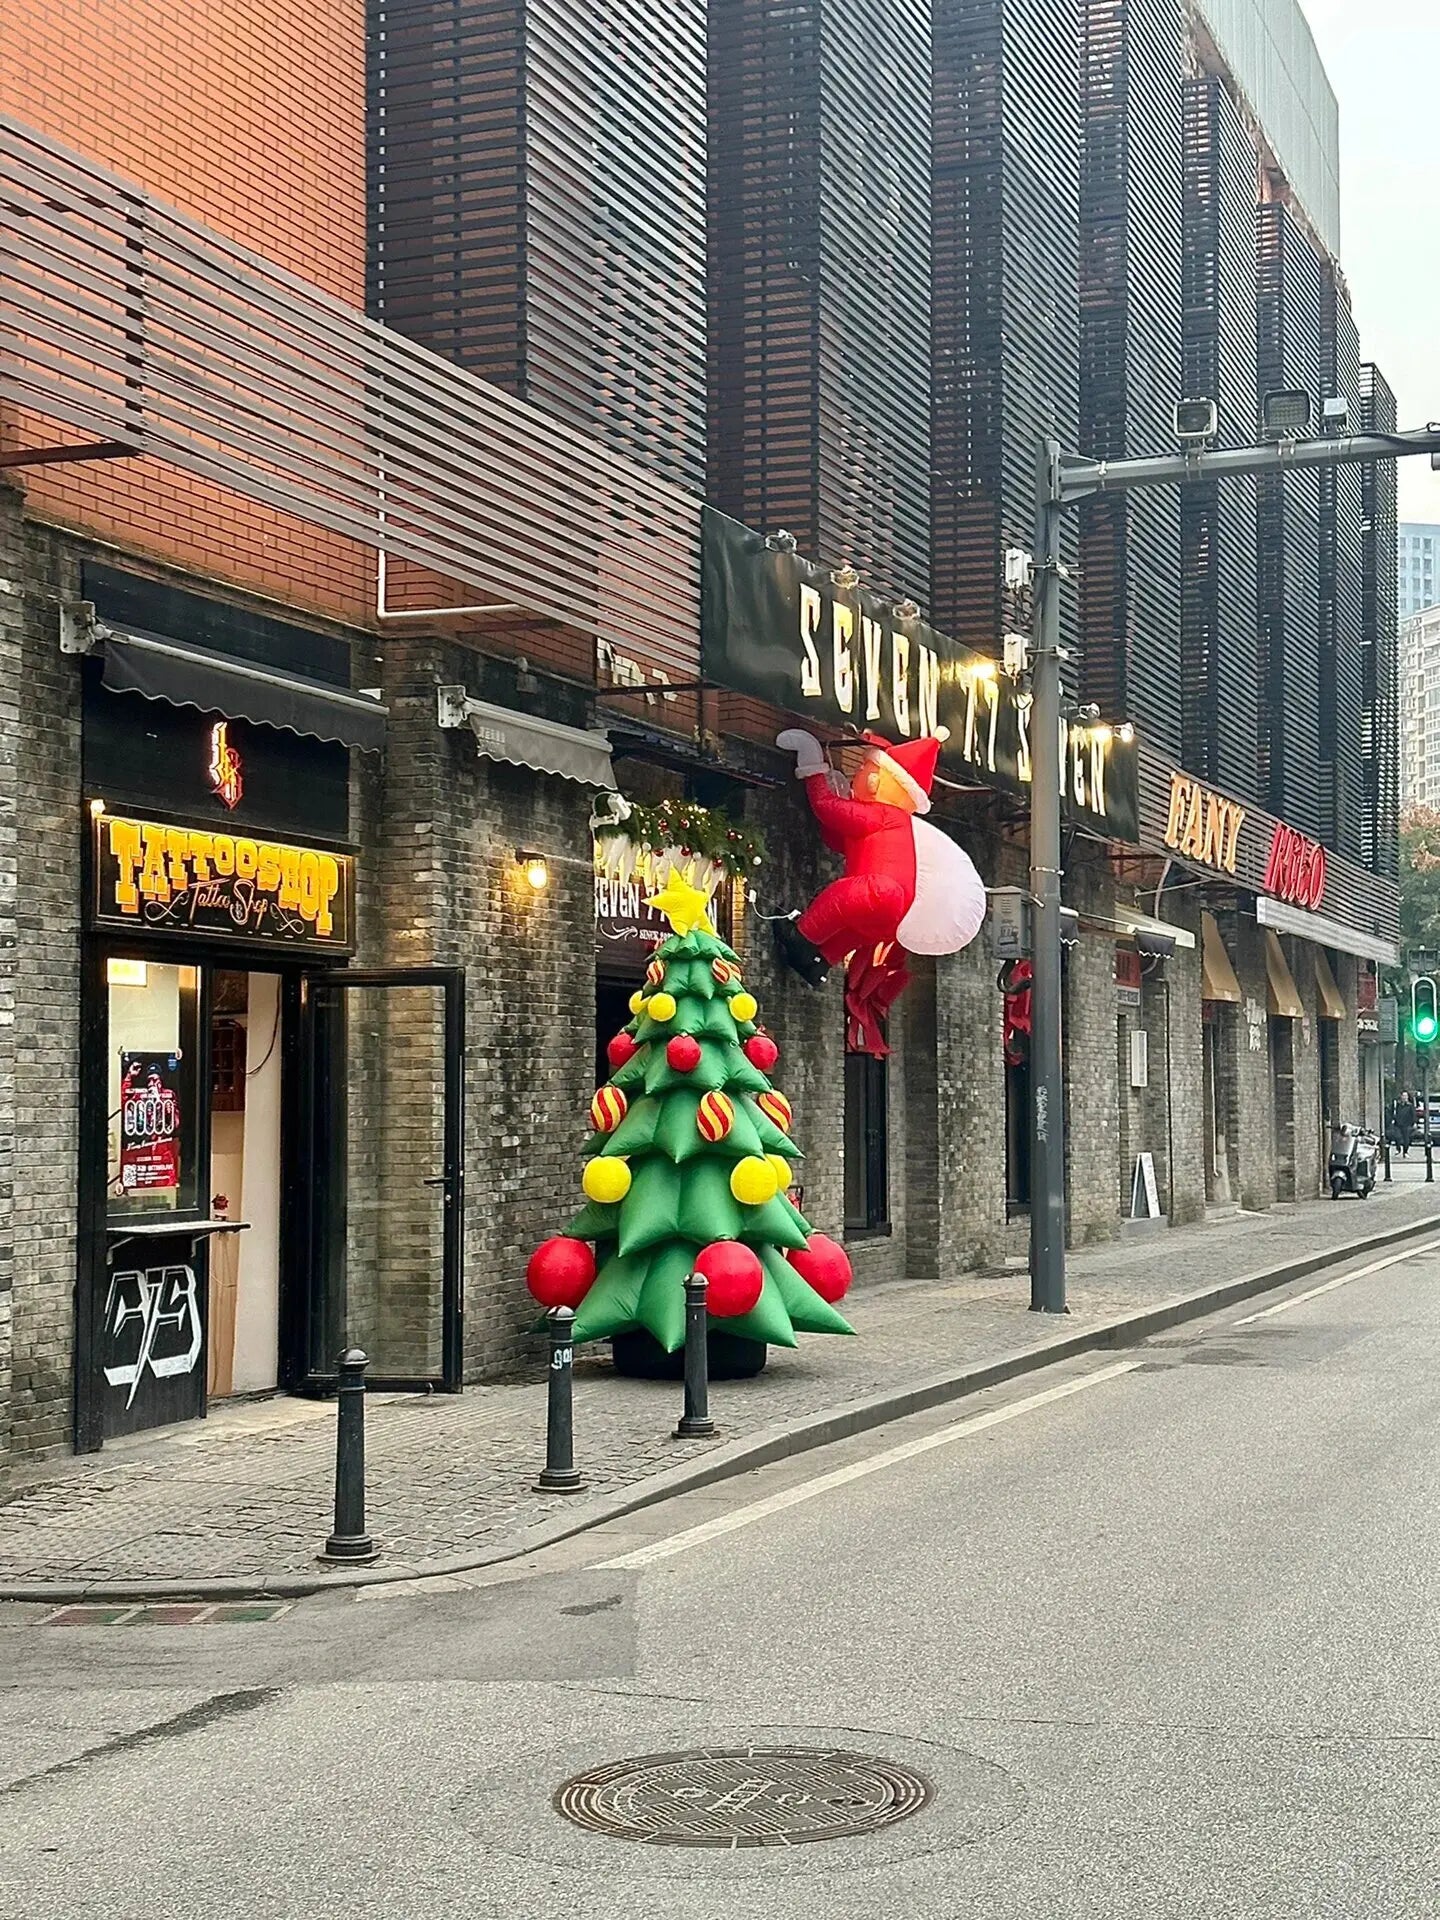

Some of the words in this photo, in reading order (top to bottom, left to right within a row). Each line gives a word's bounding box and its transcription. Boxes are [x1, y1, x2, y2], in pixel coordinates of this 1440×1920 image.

[800, 582, 940, 739] SEVEN
[1165, 771, 1245, 874] FANY
[230, 878, 269, 930] Shop
